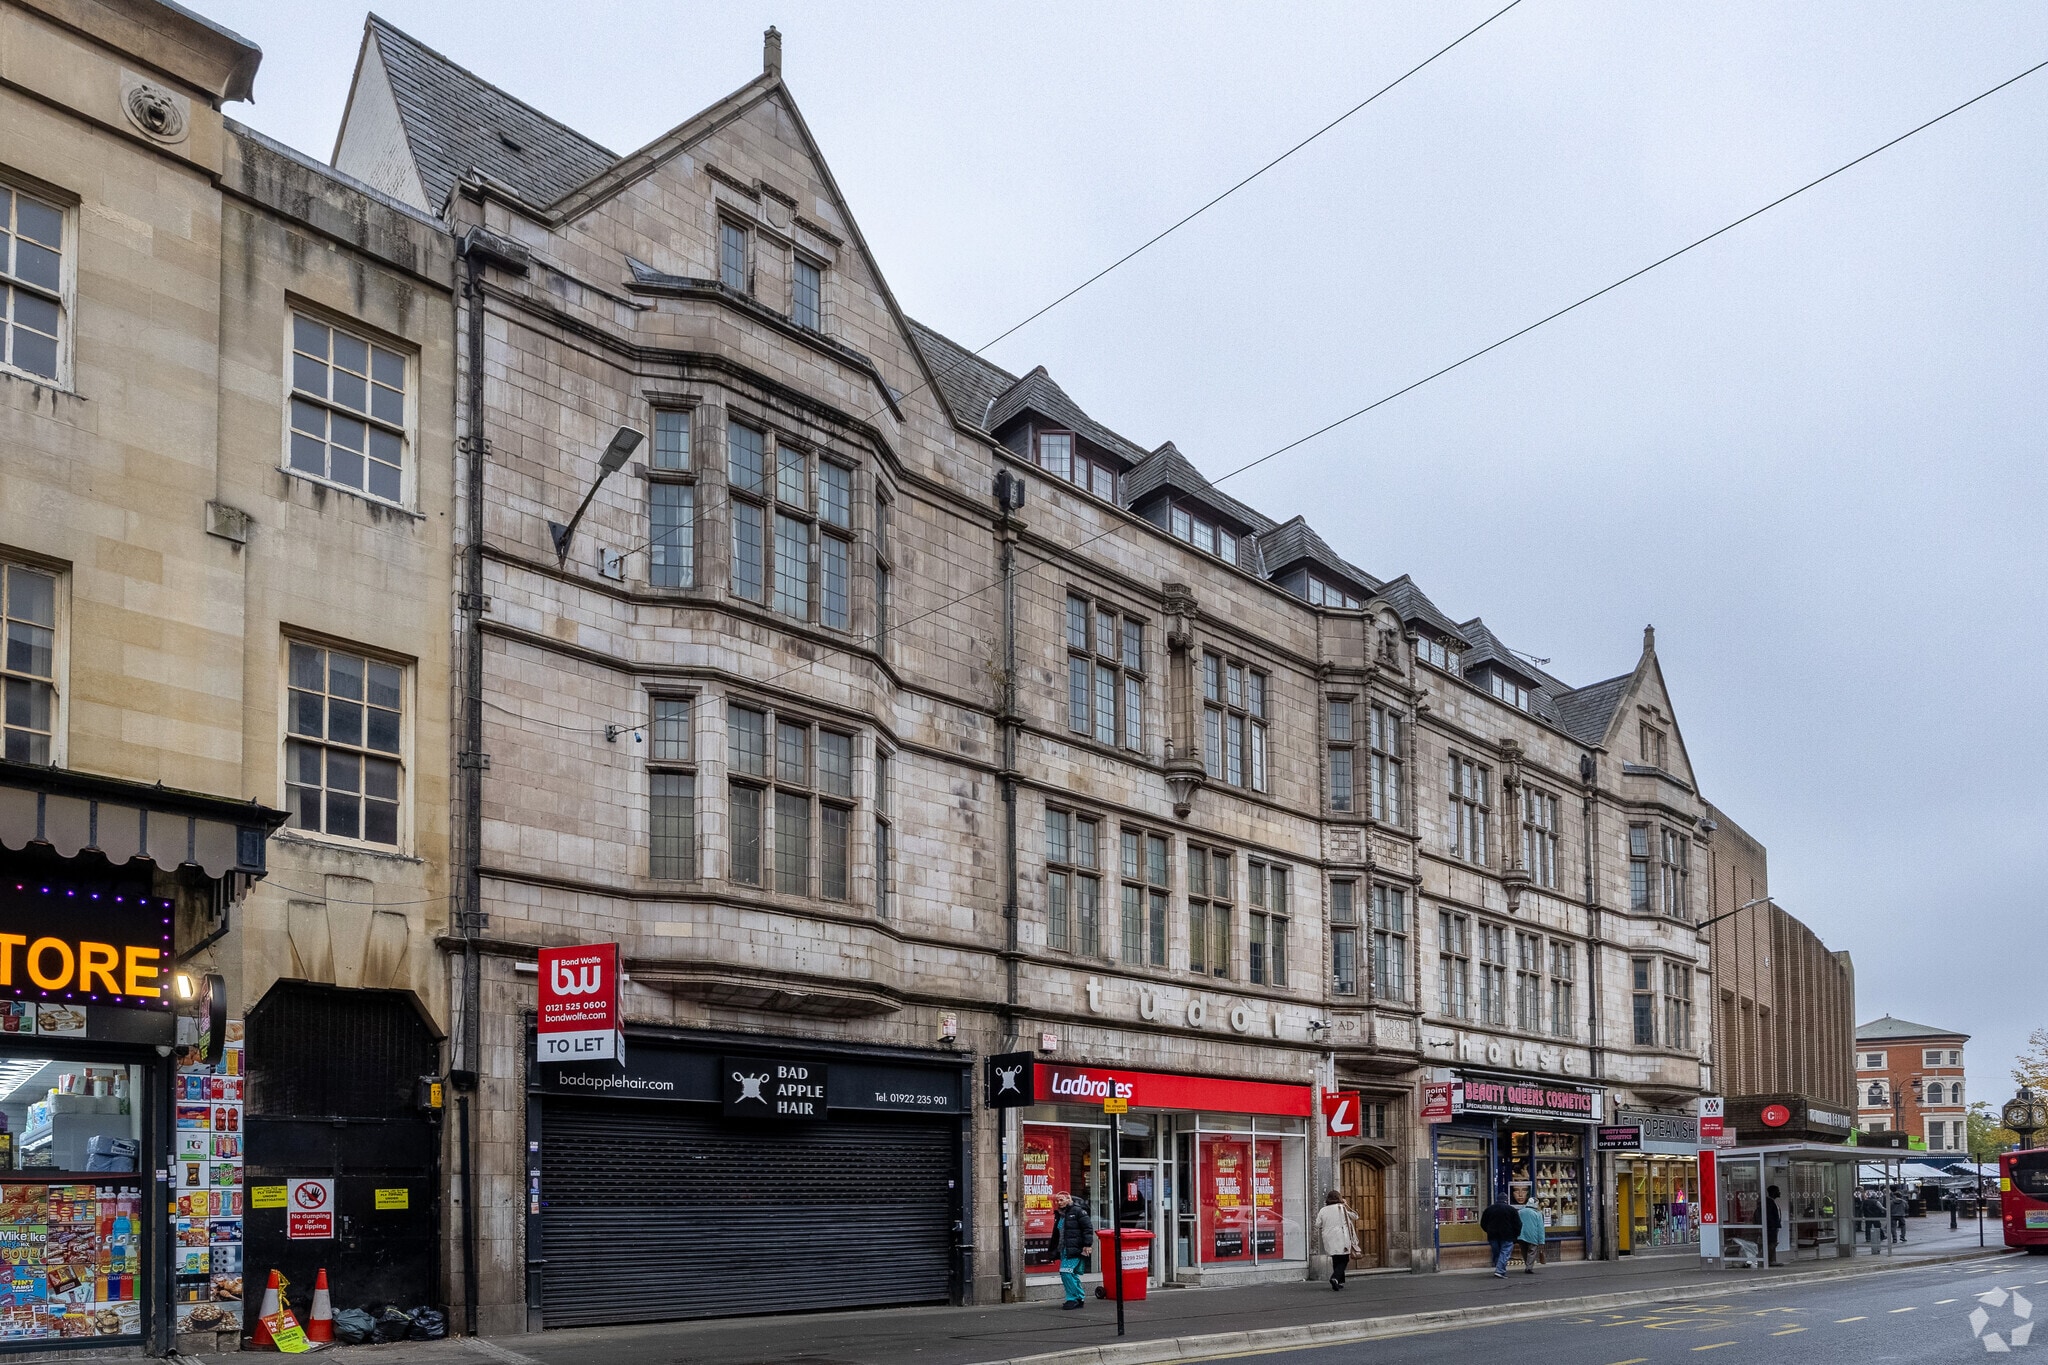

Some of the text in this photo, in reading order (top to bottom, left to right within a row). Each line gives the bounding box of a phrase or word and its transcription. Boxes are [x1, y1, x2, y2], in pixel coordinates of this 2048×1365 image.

[0, 933, 161, 998] TORE
[561, 956, 601, 966] Bond Wolfe
[545, 1000, 607, 1012] 0121 525 0600
[545, 1011, 607, 1023] bondwolfe.com
[547, 1037, 604, 1054] TO LET
[1459, 1030, 1574, 1073] house
[777, 1066, 808, 1080] BAD
[559, 1071, 674, 1091] badapplehair.com
[776, 1083, 824, 1098] APPLE
[1465, 1082, 1591, 1111] BEAUTY QUEENS COSMETICS
[875, 1092, 947, 1105] Tel. 01922 235 901
[777, 1101, 814, 1115] HAIR
[1034, 1175, 1048, 1185] LOVE
[1024, 1185, 1053, 1195] REWARDS
[0, 1231, 46, 1242] Mike Ike
